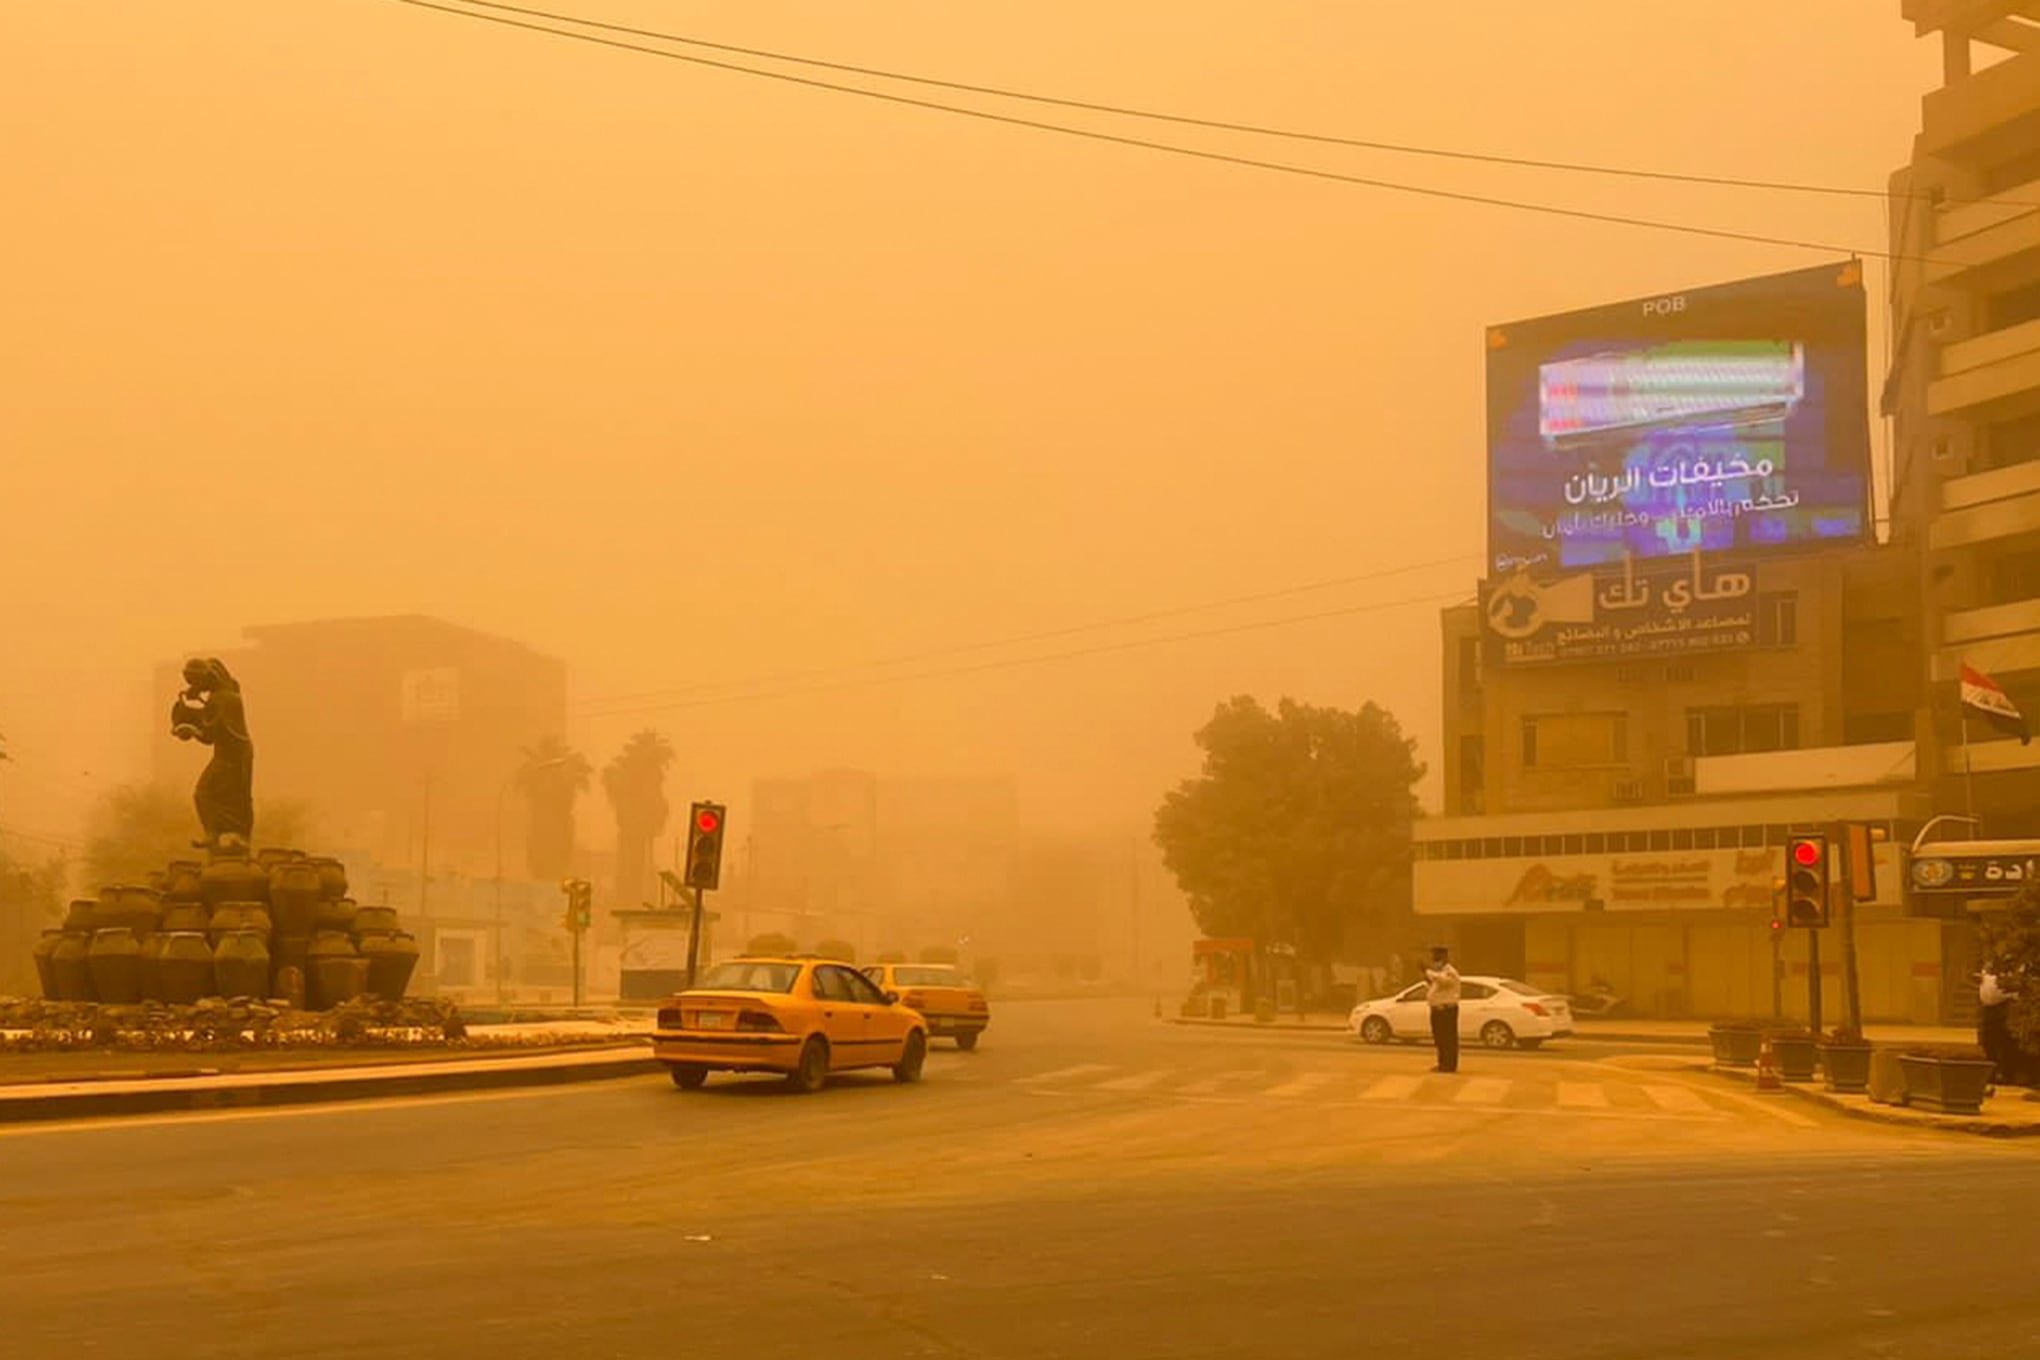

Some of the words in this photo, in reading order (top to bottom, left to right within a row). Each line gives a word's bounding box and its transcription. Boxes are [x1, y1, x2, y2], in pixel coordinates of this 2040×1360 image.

[1643, 296, 1685, 317] POB
[1565, 466, 1640, 503] الريان
[1599, 552, 1649, 609] تك
[1663, 548, 1750, 613] هاي
